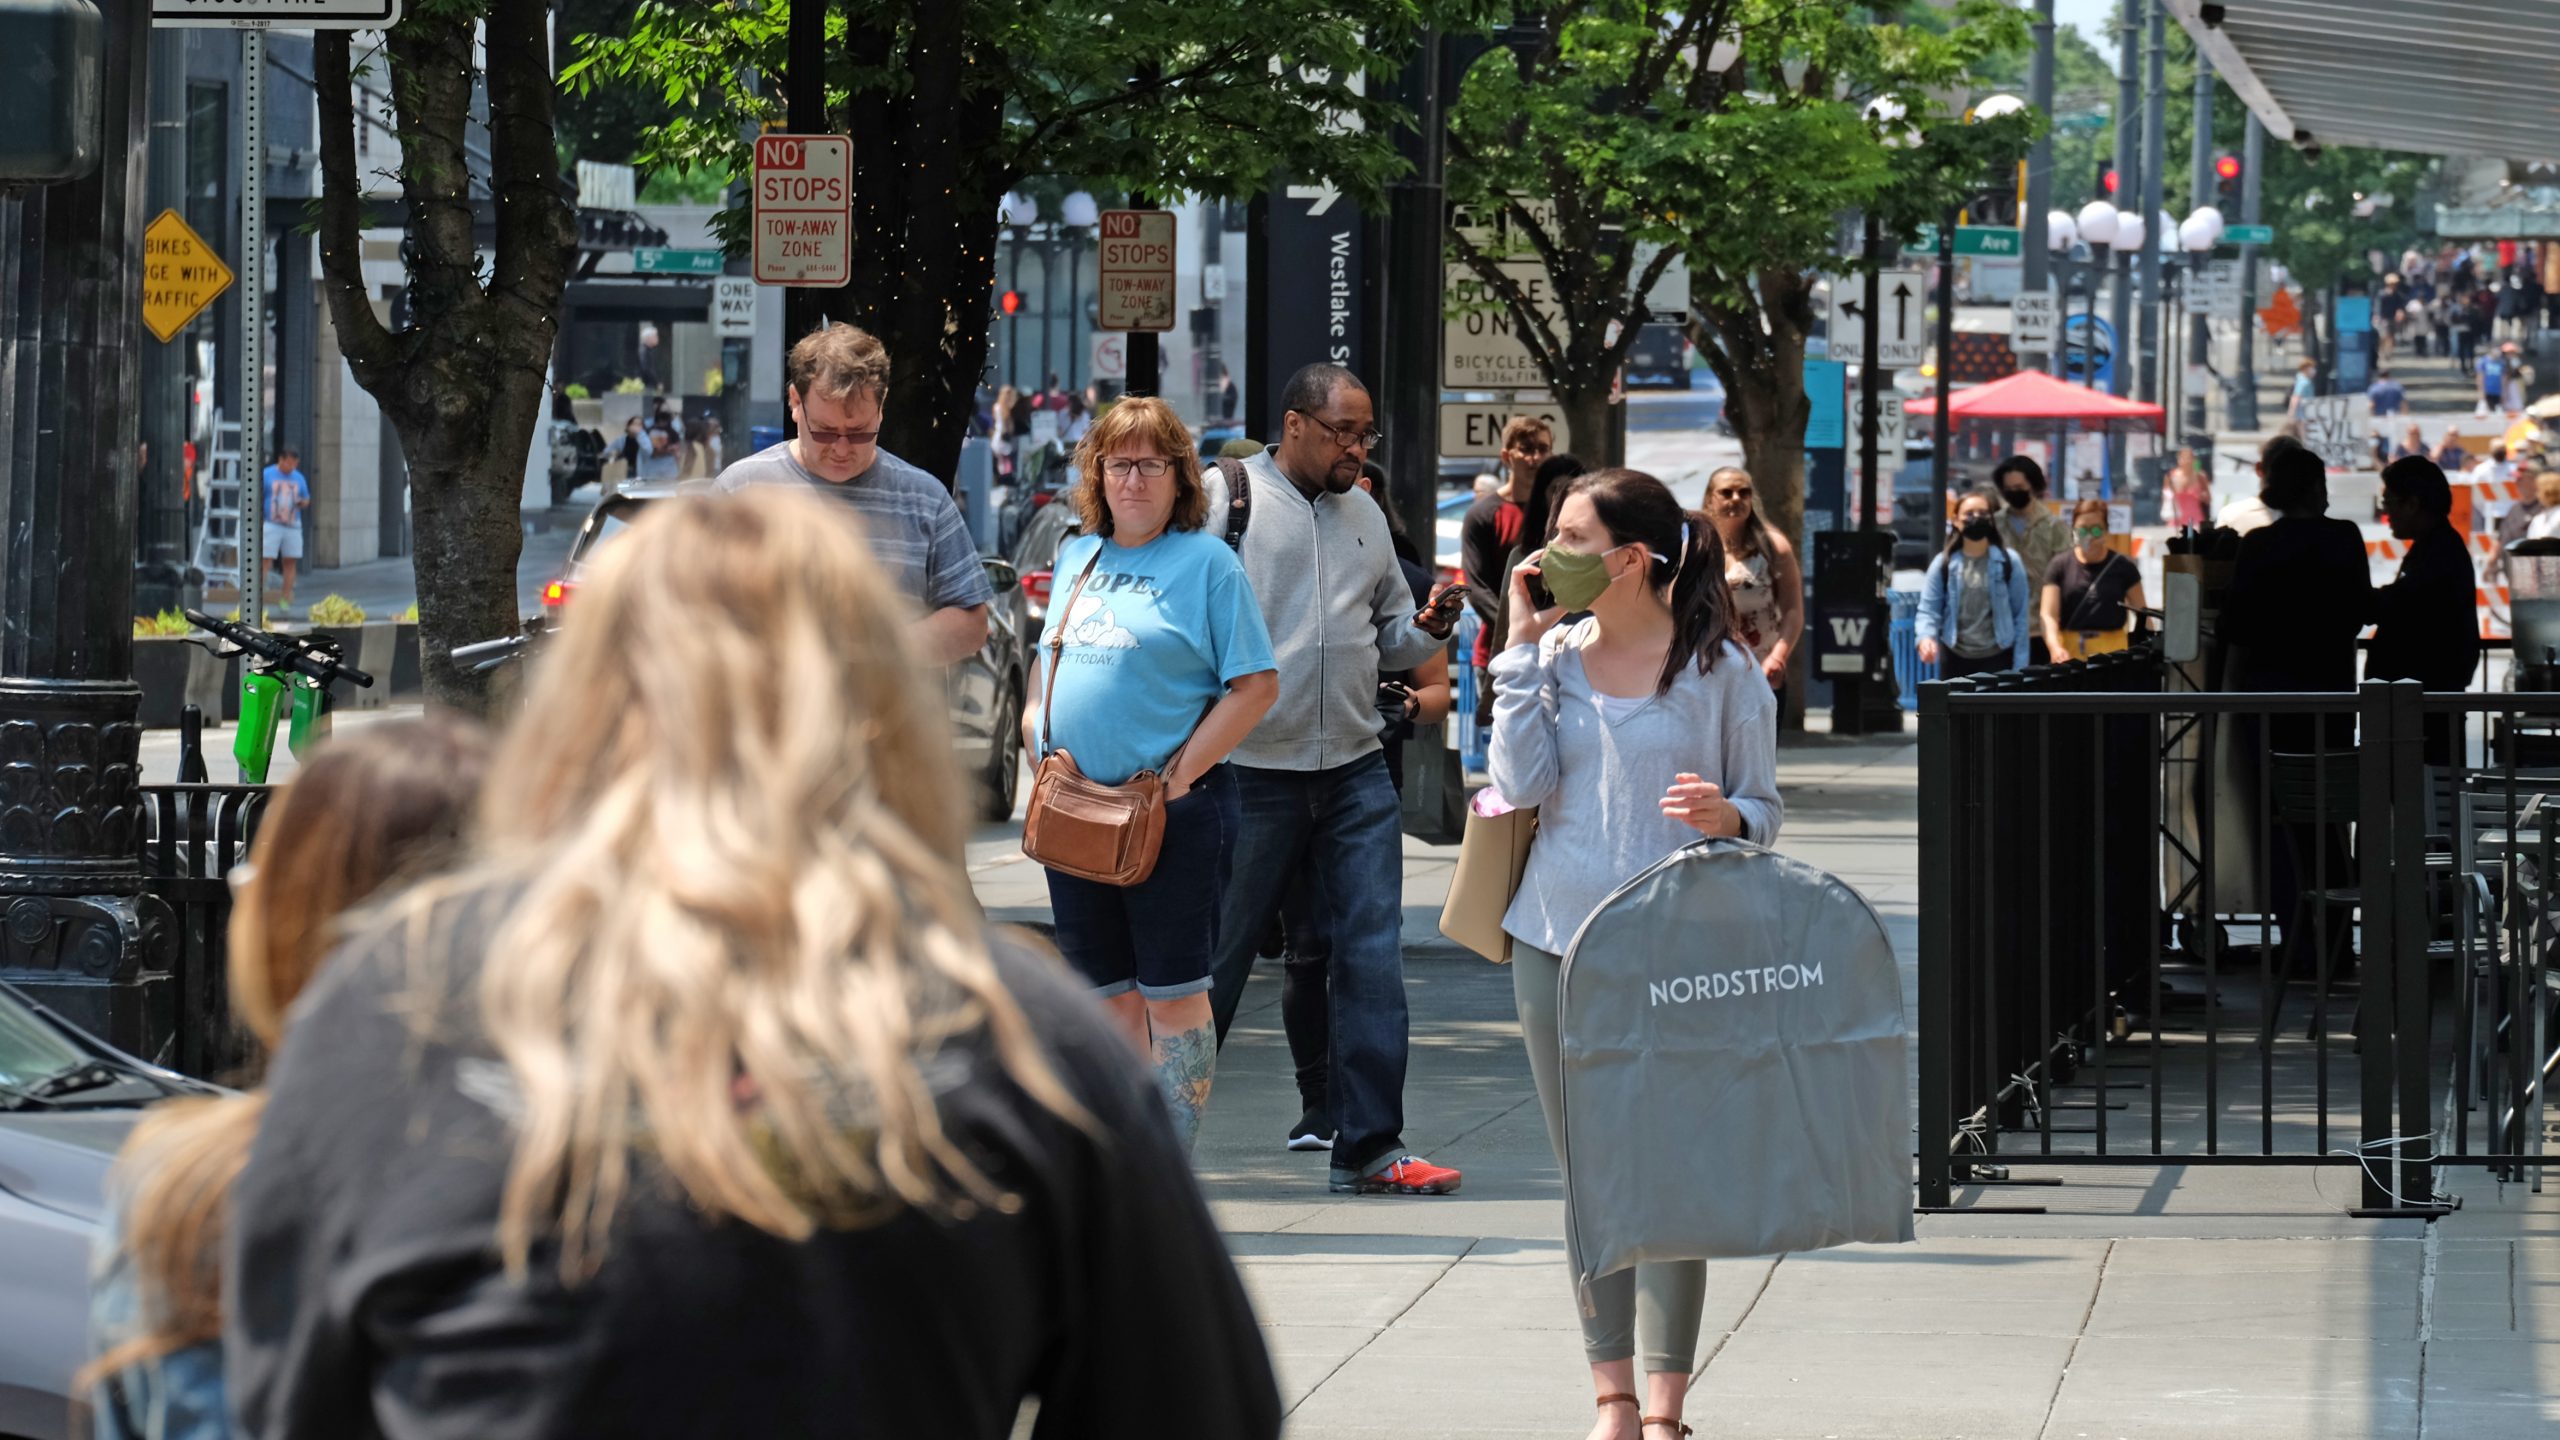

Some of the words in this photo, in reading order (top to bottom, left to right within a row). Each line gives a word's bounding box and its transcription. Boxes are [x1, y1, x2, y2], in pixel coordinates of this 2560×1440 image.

[763, 141, 799, 166] NO
[764, 177, 842, 201] STOPS
[766, 220, 837, 236] TOW-AWAY
[1106, 215, 1135, 236] NO
[145, 239, 191, 256] BIKES
[782, 241, 822, 257] ZONE
[1980, 233, 2011, 251] Ave
[1107, 244, 1169, 264] STOPS
[691, 256, 715, 269] Ave
[181, 266, 218, 282] WITH
[720, 283, 753, 297] ONE
[1109, 278, 1165, 292] TOW-AWAY
[1331, 231, 1350, 337] Westlake
[1456, 279, 1562, 304] BUE
[144, 290, 199, 308] RAFFIC
[720, 300, 754, 312] WAY
[1121, 295, 1153, 309] ZONE
[2016, 298, 2049, 311] ONE
[1466, 311, 1555, 335] ON
[2016, 315, 2049, 327] WAY
[1832, 343, 1863, 358] ONL
[1880, 344, 1920, 359] ONLY
[1829, 617, 1869, 646] W
[1075, 653, 1114, 666] TODAY.
[1649, 961, 1824, 1007] NORDSTROM
